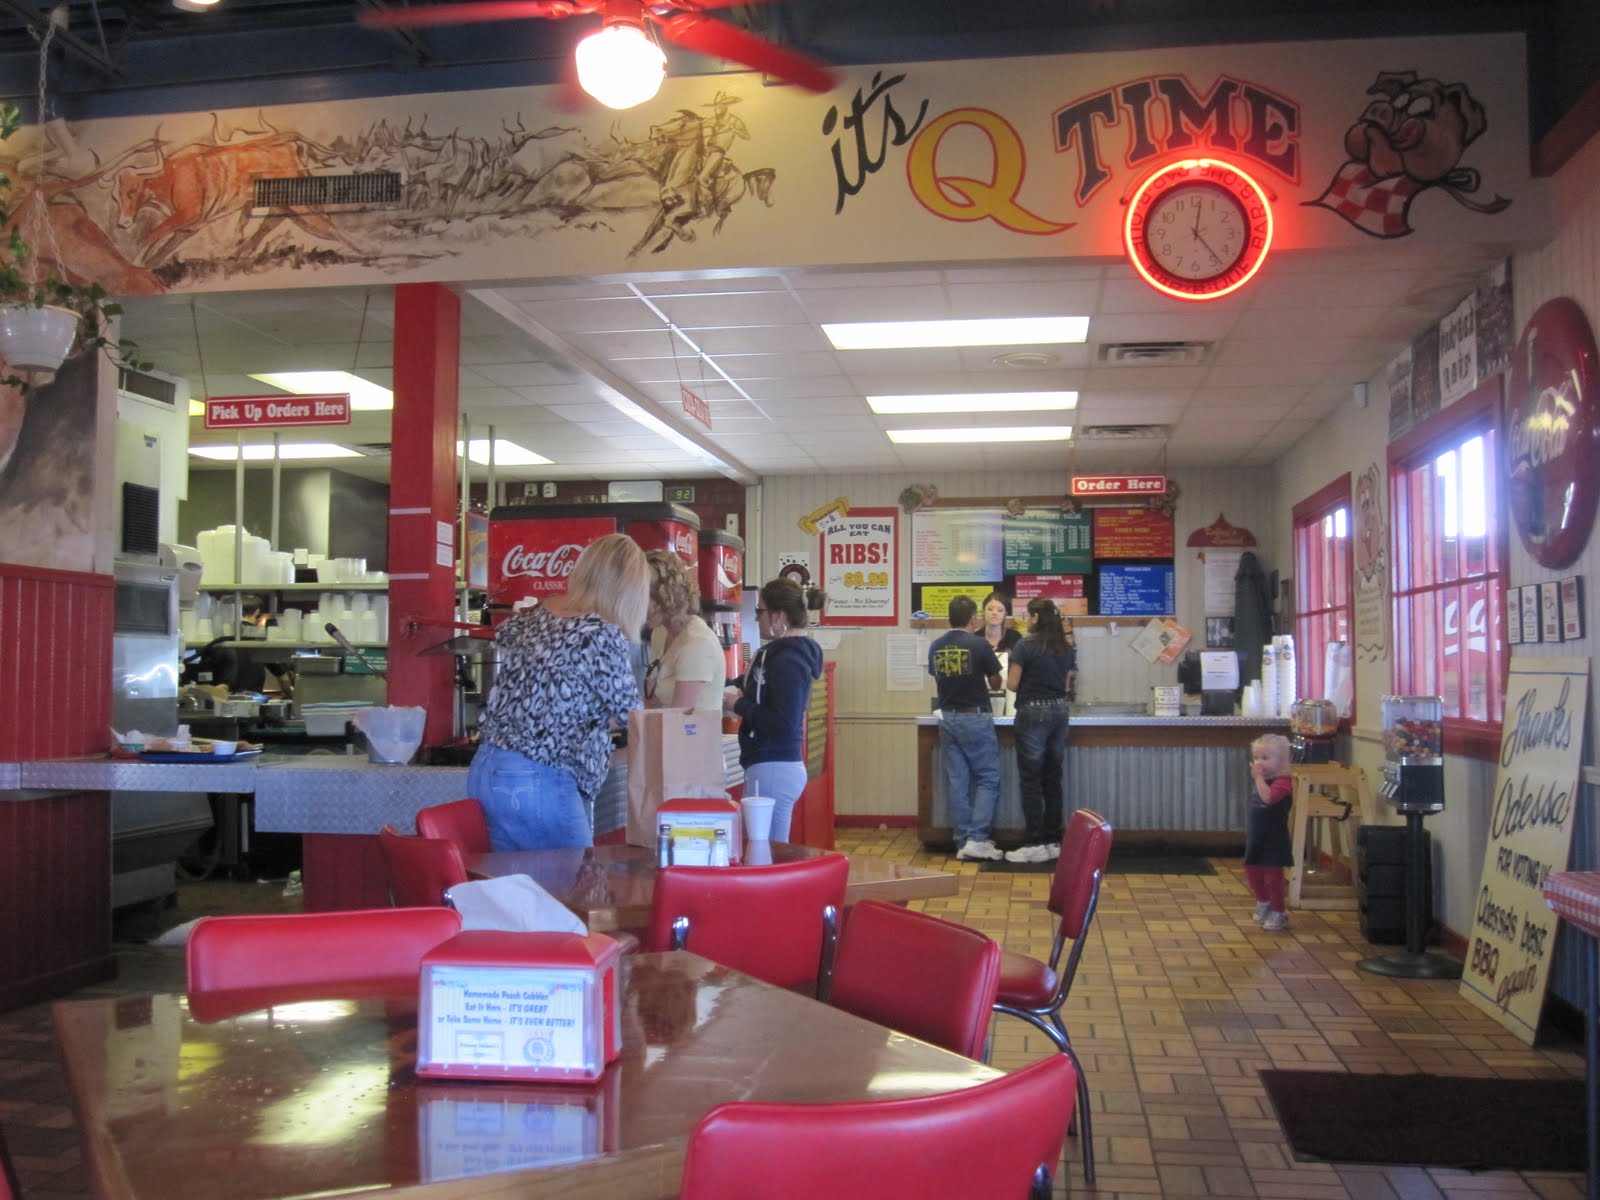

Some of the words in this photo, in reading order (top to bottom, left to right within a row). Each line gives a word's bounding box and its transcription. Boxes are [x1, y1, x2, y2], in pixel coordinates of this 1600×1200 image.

[821, 70, 930, 215] it's
[906, 105, 1079, 237] Q
[1052, 72, 1302, 209] TIME
[211, 404, 240, 420] Pick
[244, 404, 263, 421] Up
[267, 402, 310, 418] Orders
[314, 401, 345, 416] Here
[676, 490, 690, 499] 92
[1077, 480, 1121, 490] Order
[1127, 479, 1161, 489] Here
[827, 524, 846, 536] ALL
[871, 523, 891, 534] CAN
[502, 544, 586, 578] Coca-Co
[830, 542, 889, 565] RIBS!
[533, 581, 566, 590] CLASSIC
[1501, 676, 1573, 768] Thanks
[1496, 846, 1512, 877] FOR
[1512, 852, 1540, 890] VOTING
[1520, 911, 1548, 960] best
[1471, 937, 1499, 984] BBQ
[1497, 957, 1537, 1013] again
[463, 989, 499, 999] Homemade
[502, 990, 521, 1000] Peach
[523, 991, 549, 1001] Cobbler
[465, 1003, 476, 1011] Eat
[478, 1003, 484, 1011] It
[486, 1003, 502, 1012] Here
[509, 1003, 522, 1013] IT'S
[524, 1004, 548, 1014] GREAT
[446, 1014, 461, 1023] Take
[463, 1014, 481, 1024] Some
[483, 1015, 502, 1024] Home
[509, 1016, 522, 1026] IT'S
[525, 1017, 544, 1027] EVEN
[545, 1018, 576, 1028] BETTER!
